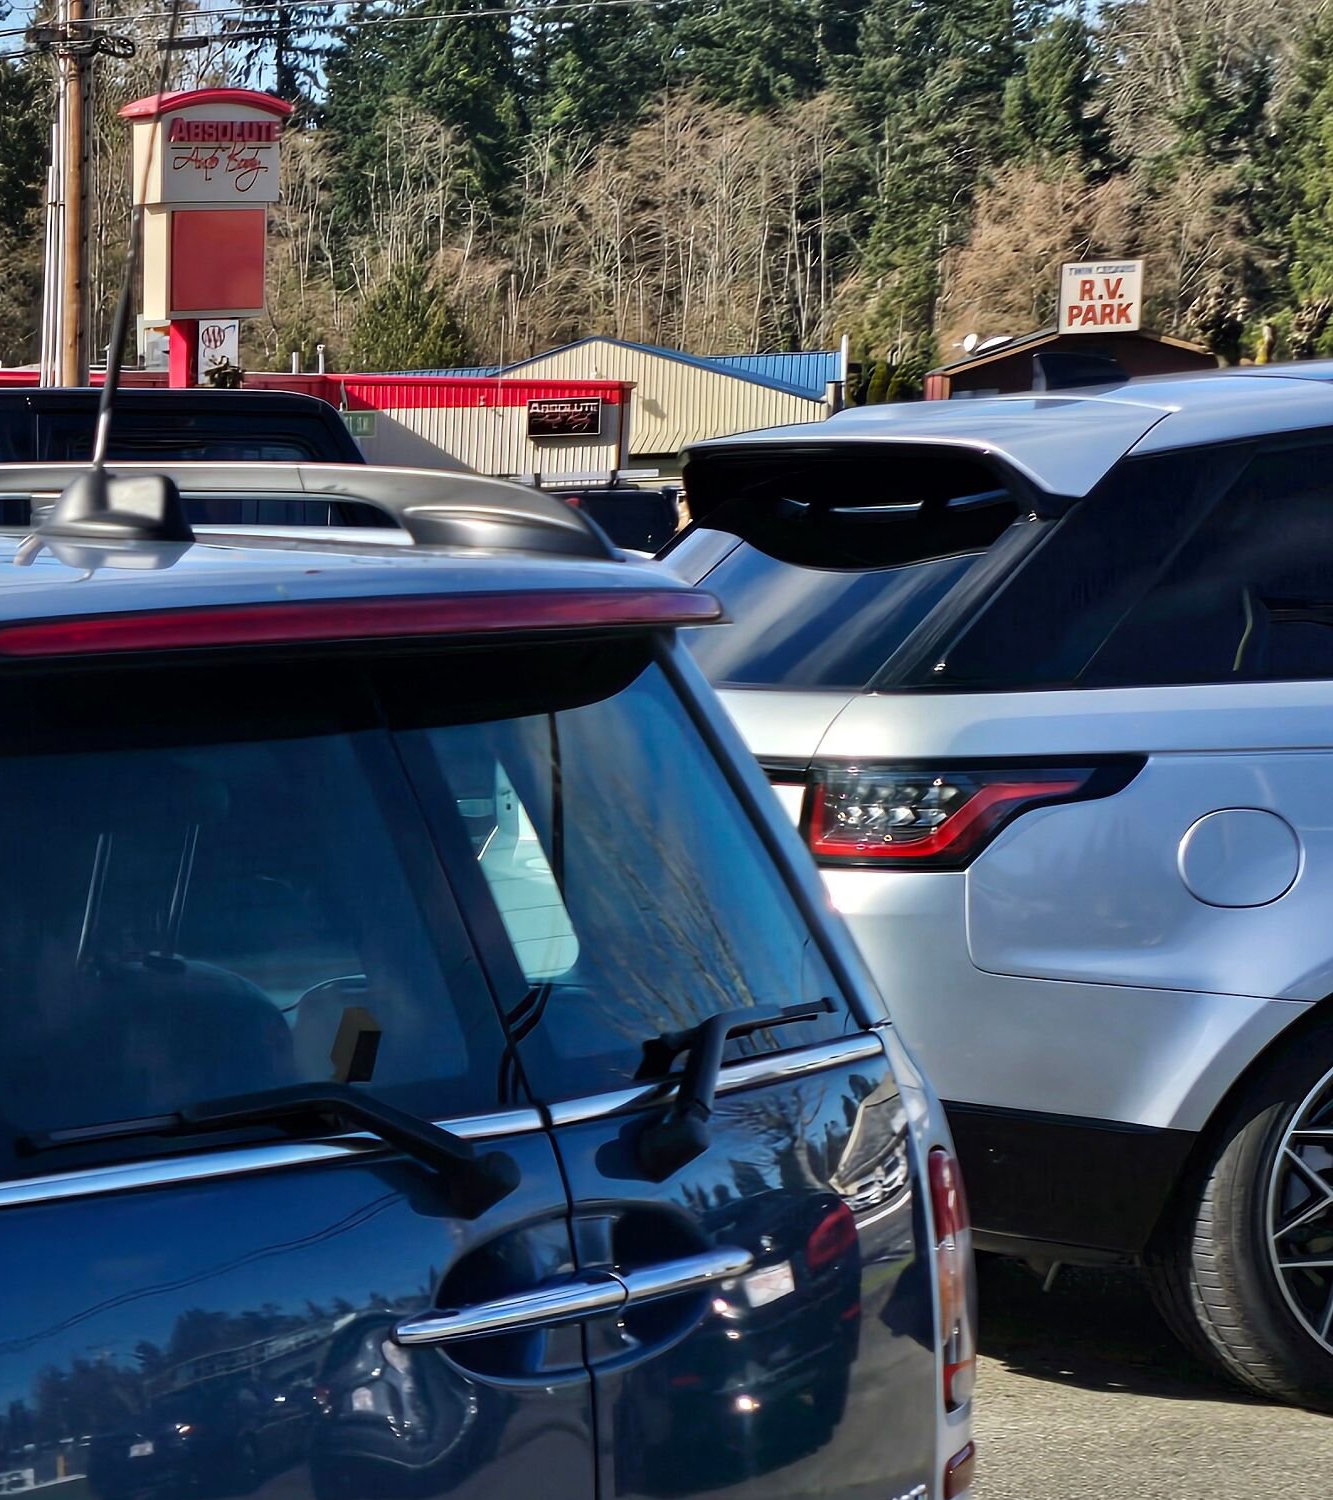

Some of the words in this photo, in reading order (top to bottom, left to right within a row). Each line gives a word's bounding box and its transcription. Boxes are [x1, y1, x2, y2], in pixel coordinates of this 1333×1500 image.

[170, 117, 283, 142] ABSOLUTE
[1079, 277, 1125, 301] R.V.
[1067, 302, 1134, 327] PARK
